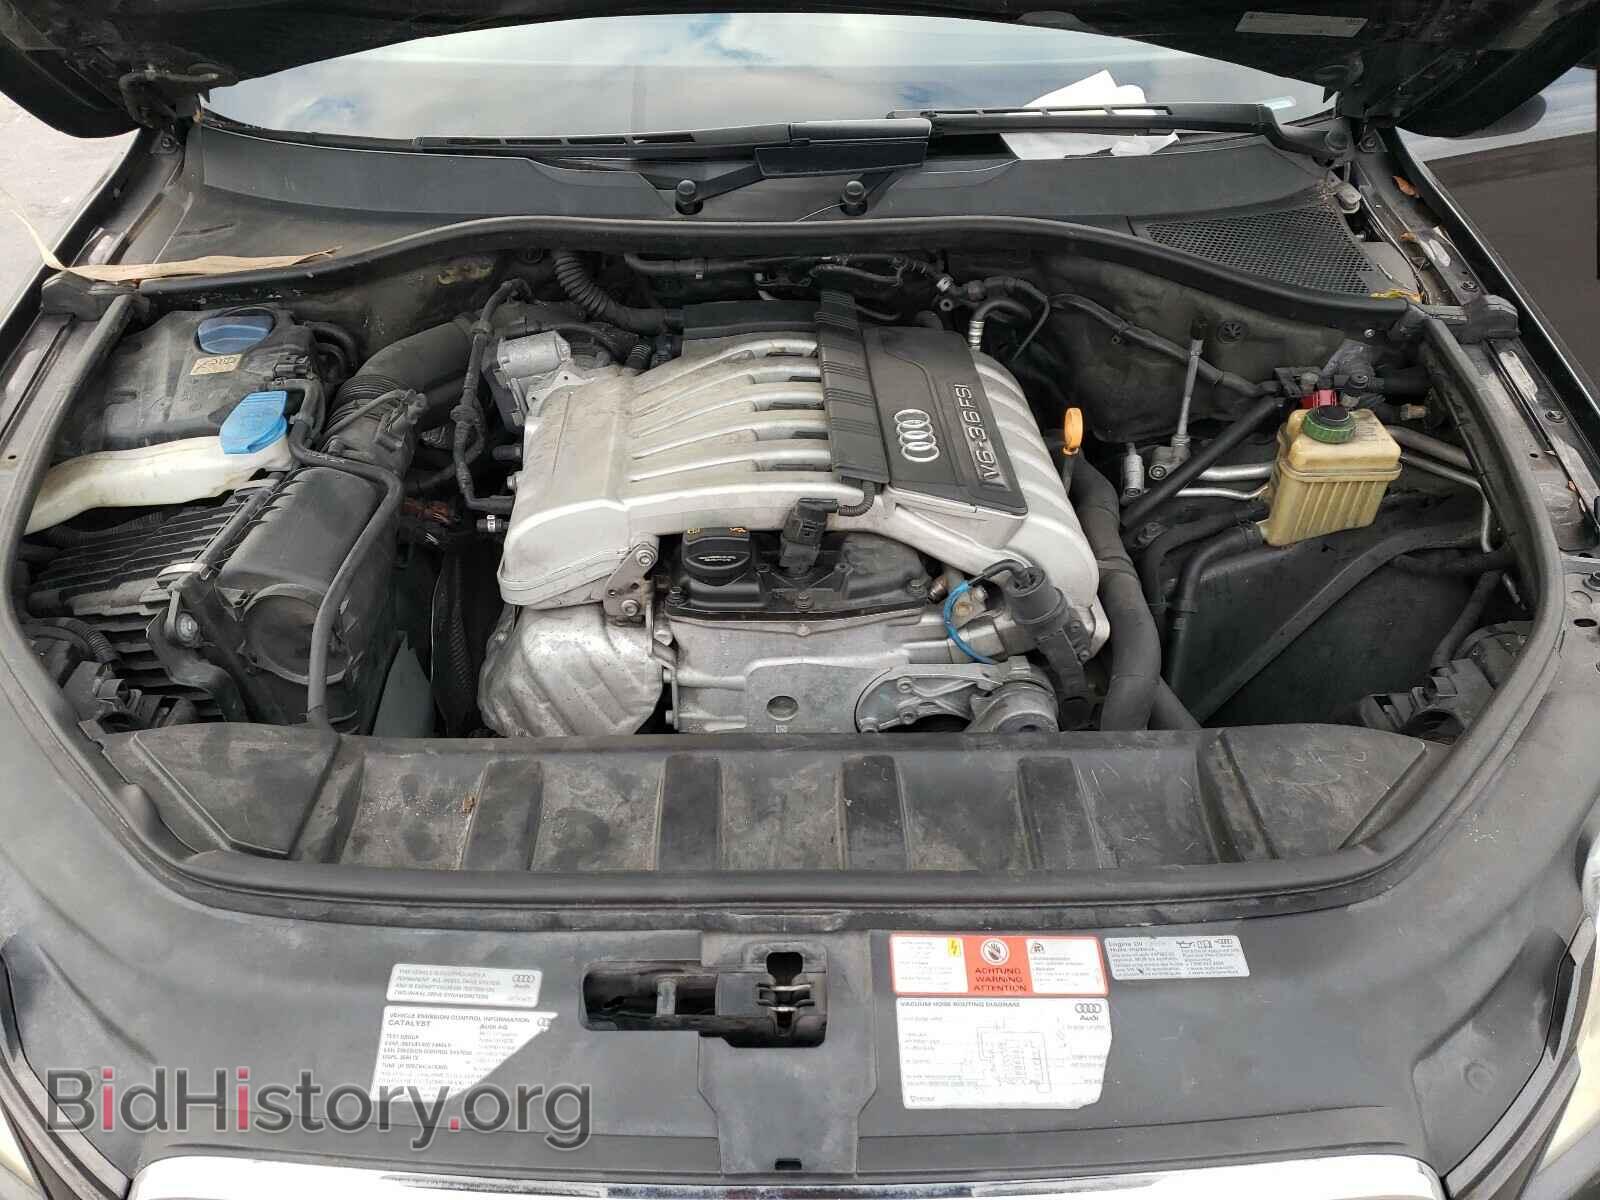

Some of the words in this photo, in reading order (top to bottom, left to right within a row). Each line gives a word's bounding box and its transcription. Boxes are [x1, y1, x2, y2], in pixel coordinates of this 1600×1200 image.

[975, 967, 1021, 976] ACHTUNG
[976, 976, 1023, 984] WARNING
[974, 984, 1027, 992] ATTENTION
[388, 1019, 431, 1027] CATALYST
[483, 1015, 530, 1023] INFORMATION
